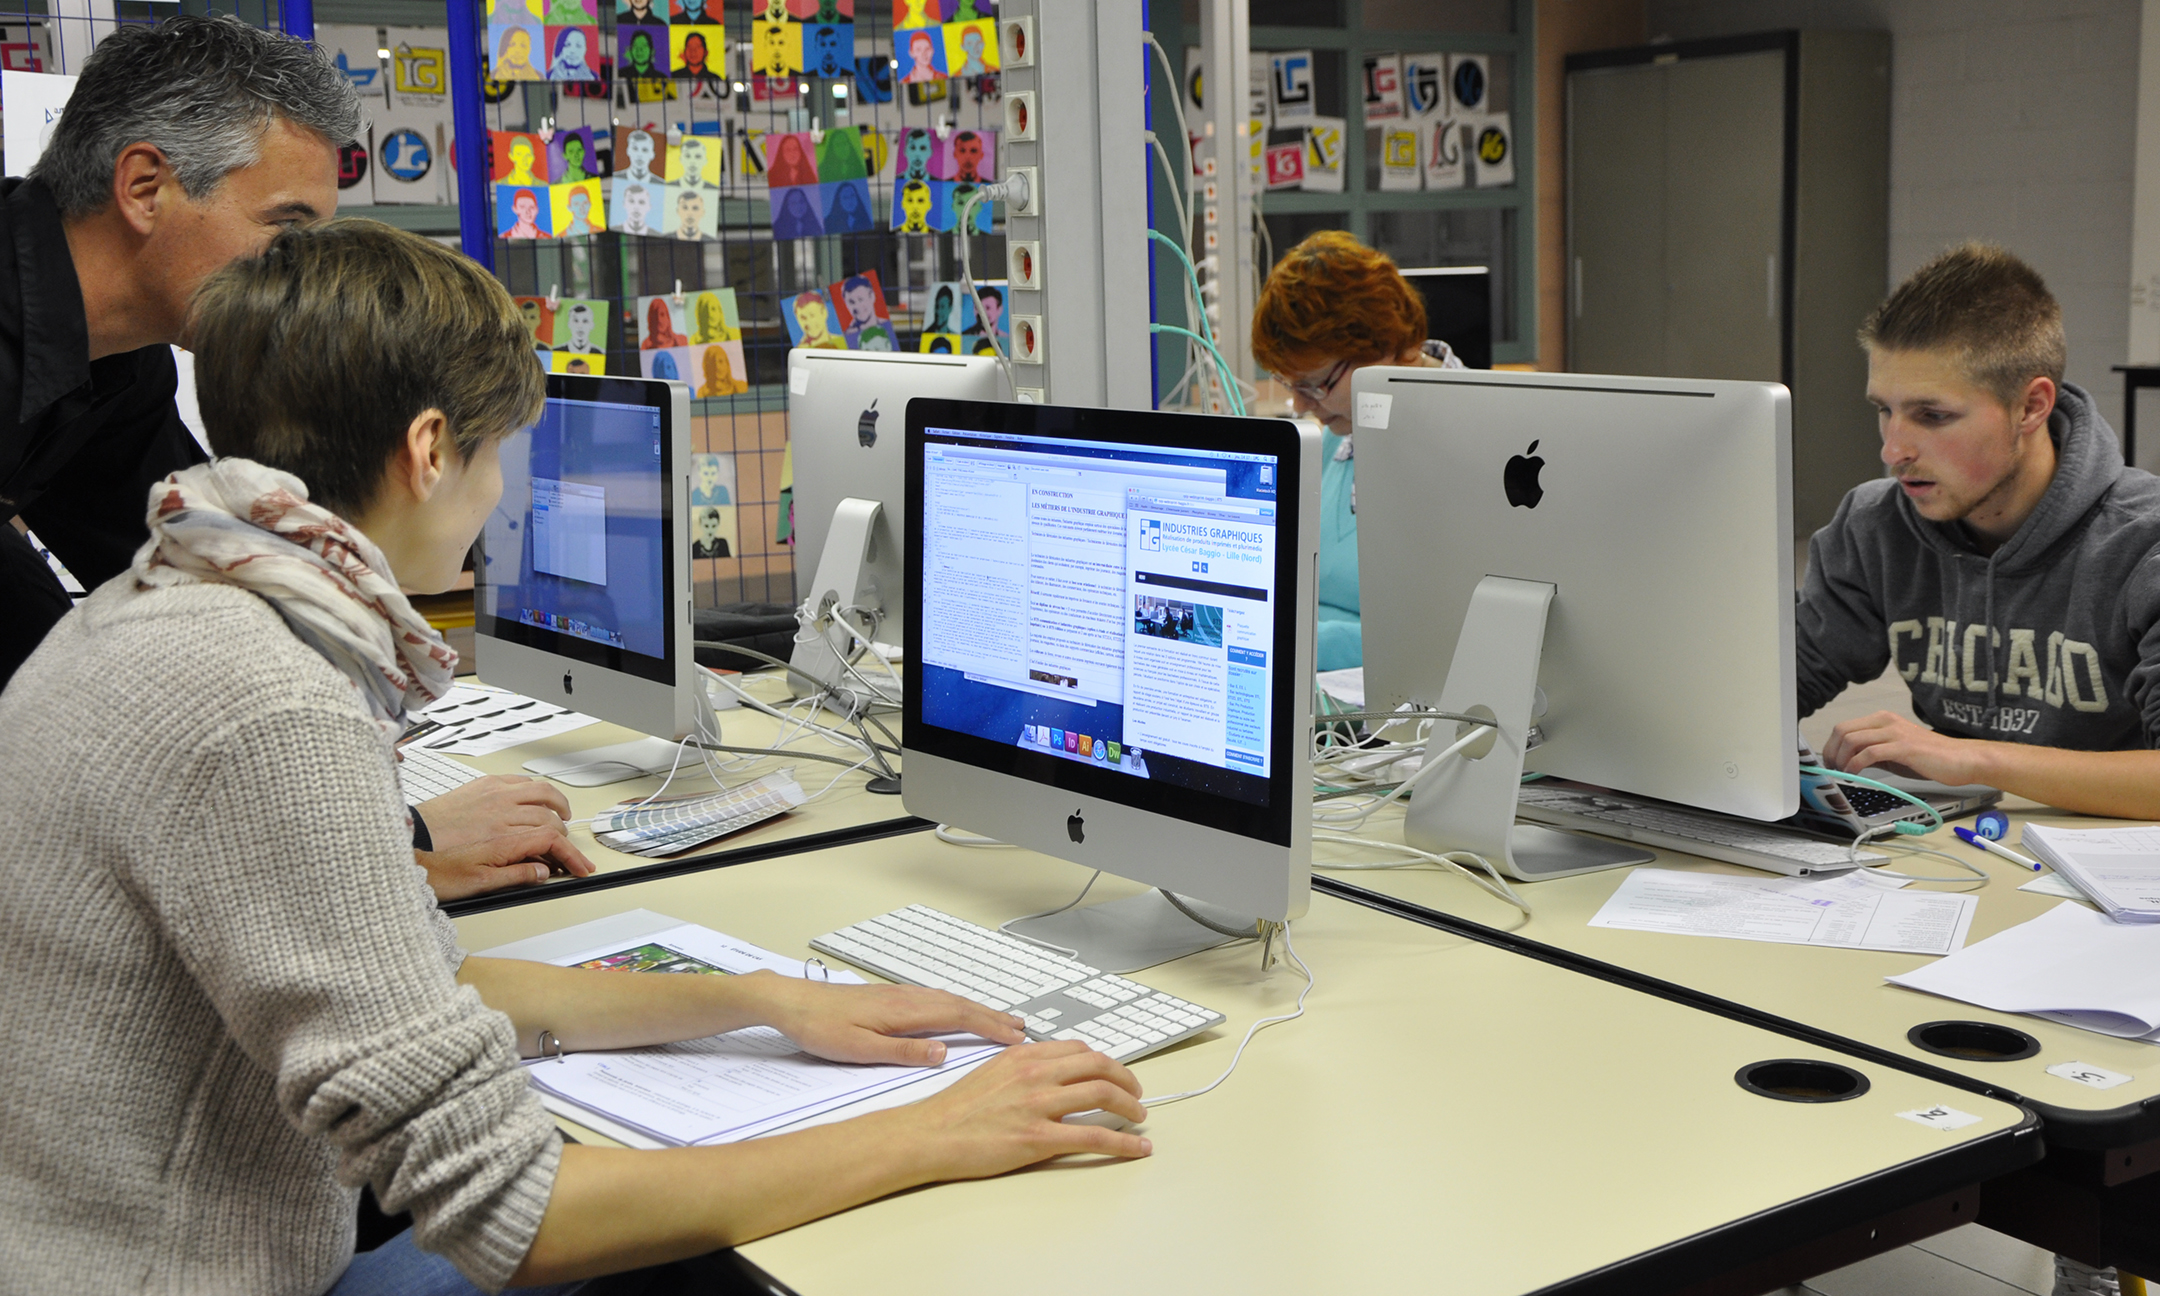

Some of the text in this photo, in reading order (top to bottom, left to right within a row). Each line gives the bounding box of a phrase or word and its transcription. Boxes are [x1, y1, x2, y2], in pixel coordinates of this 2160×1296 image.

[1162, 522, 1263, 545] INDUSTRIES GRAPHIQUES
[1162, 533, 1185, 543] Réalisation
[1192, 537, 1211, 547] produits
[1211, 540, 1232, 549] imprimés
[1238, 543, 1263, 552] plurimédia
[1162, 543, 1179, 554] Lycée
[1180, 545, 1197, 555] César
[1199, 547, 1221, 559] Baggio
[1226, 551, 1240, 561] Lille
[1241, 553, 1263, 564] (Nord)
[1053, 734, 1062, 746] Ps
[1082, 740, 1090, 752] Ai
[1108, 746, 1120, 759] Dw
